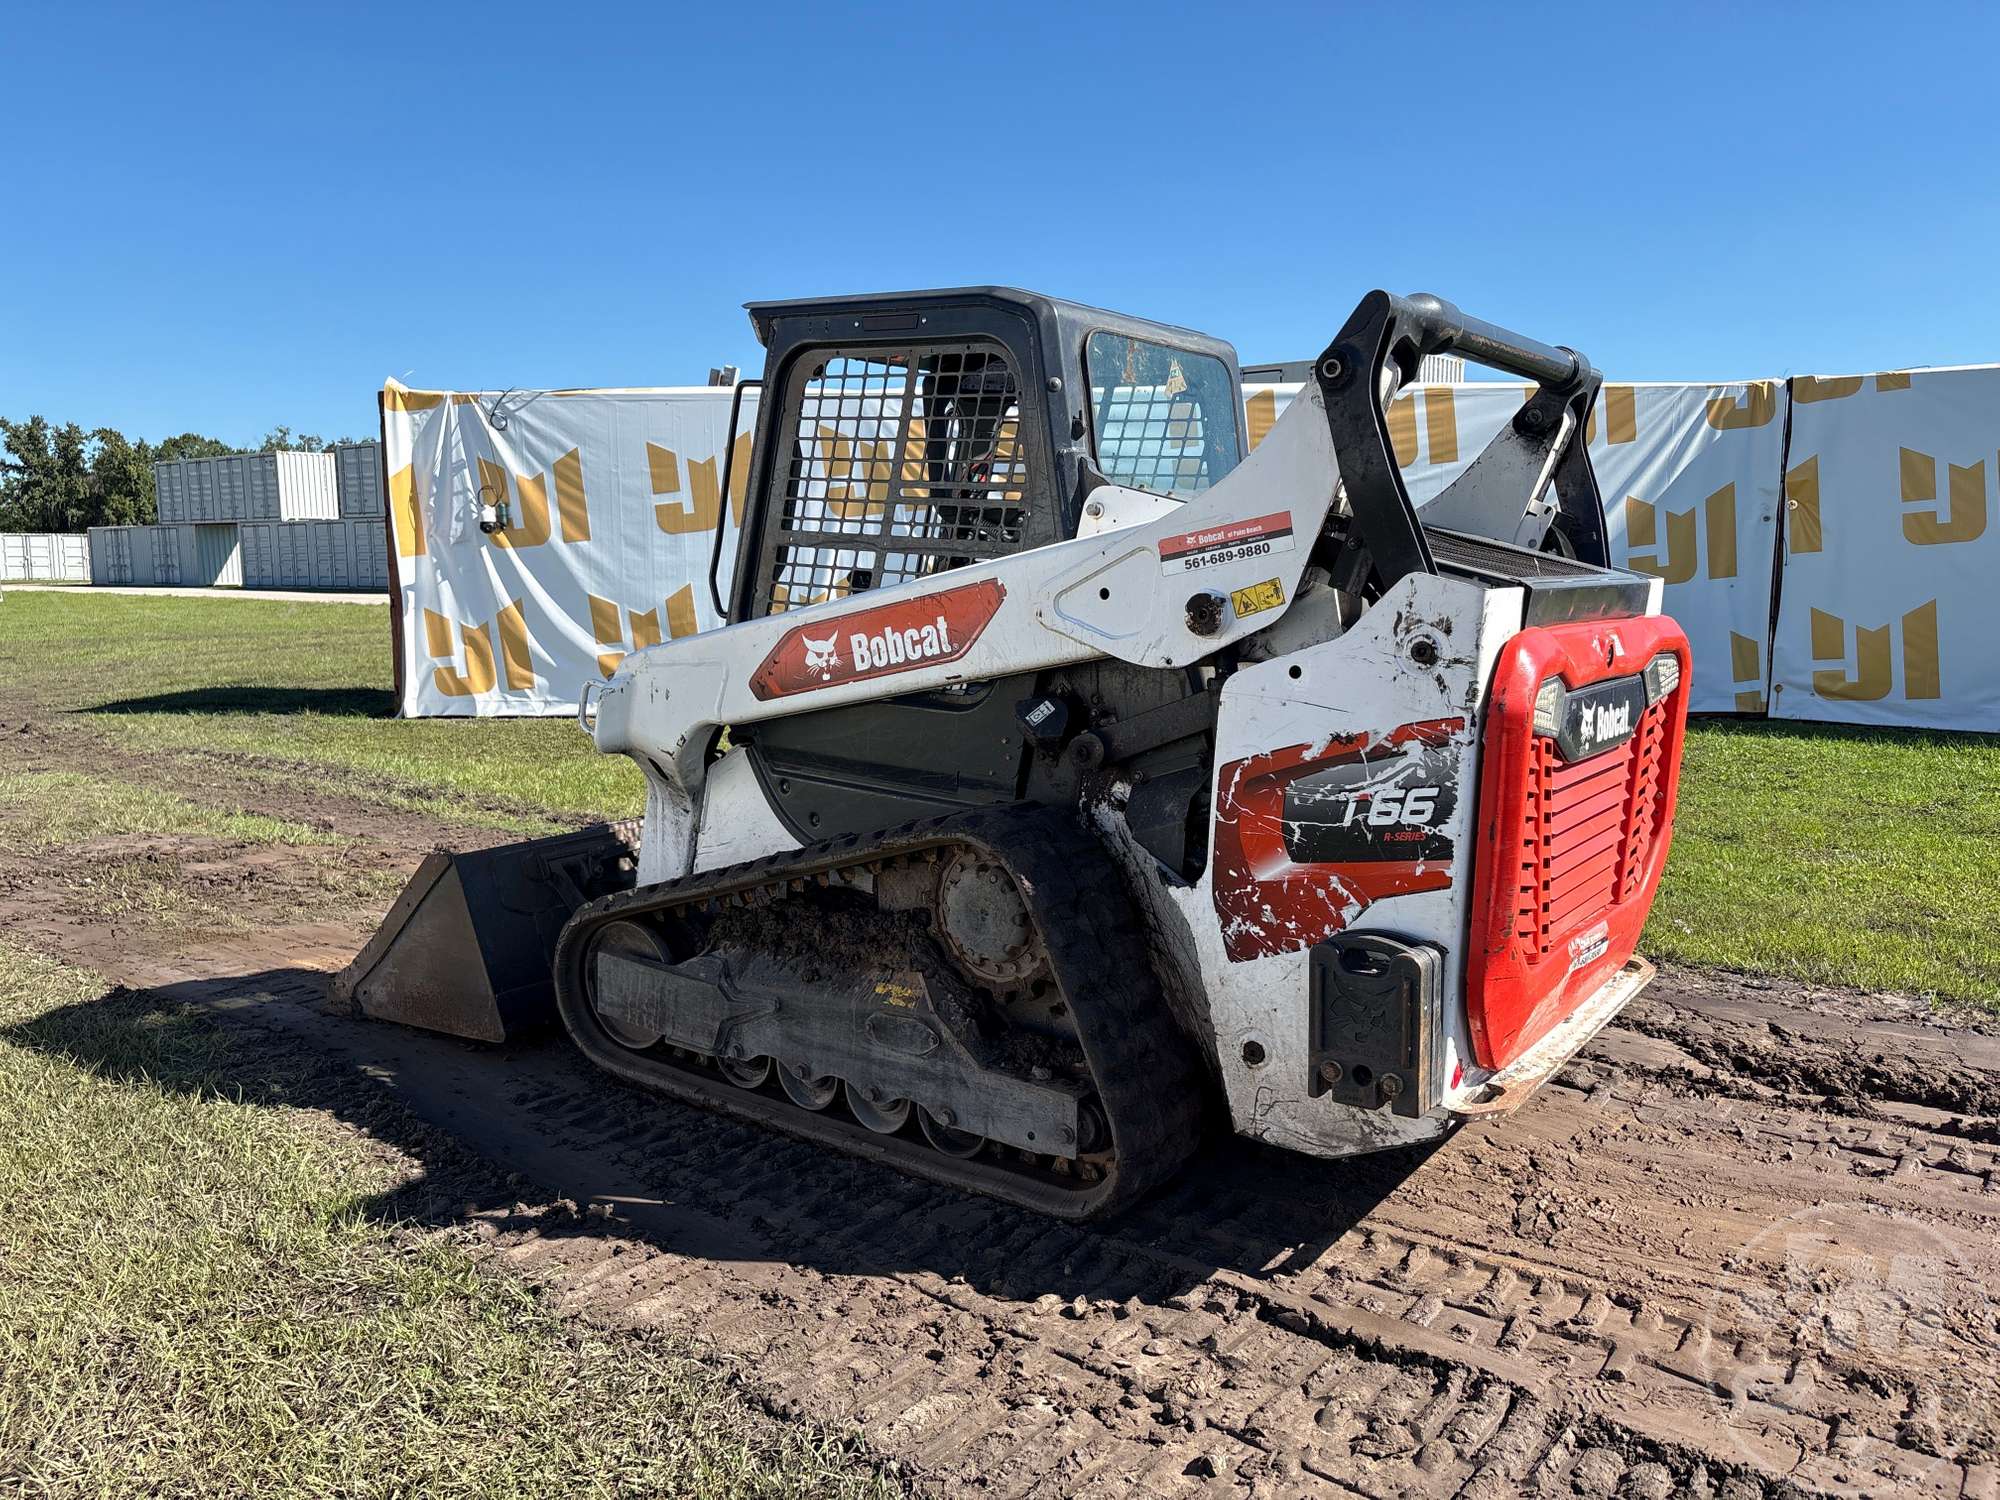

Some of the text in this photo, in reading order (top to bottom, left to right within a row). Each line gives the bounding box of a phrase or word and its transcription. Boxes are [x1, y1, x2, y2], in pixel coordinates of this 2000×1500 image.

[1198, 530, 1225, 544] Bobcat
[1184, 542, 1271, 570] 561-689-9880
[849, 615, 952, 672] Bobcat
[1596, 700, 1630, 742] Bobcat
[1383, 831, 1426, 842] R-SERIES
